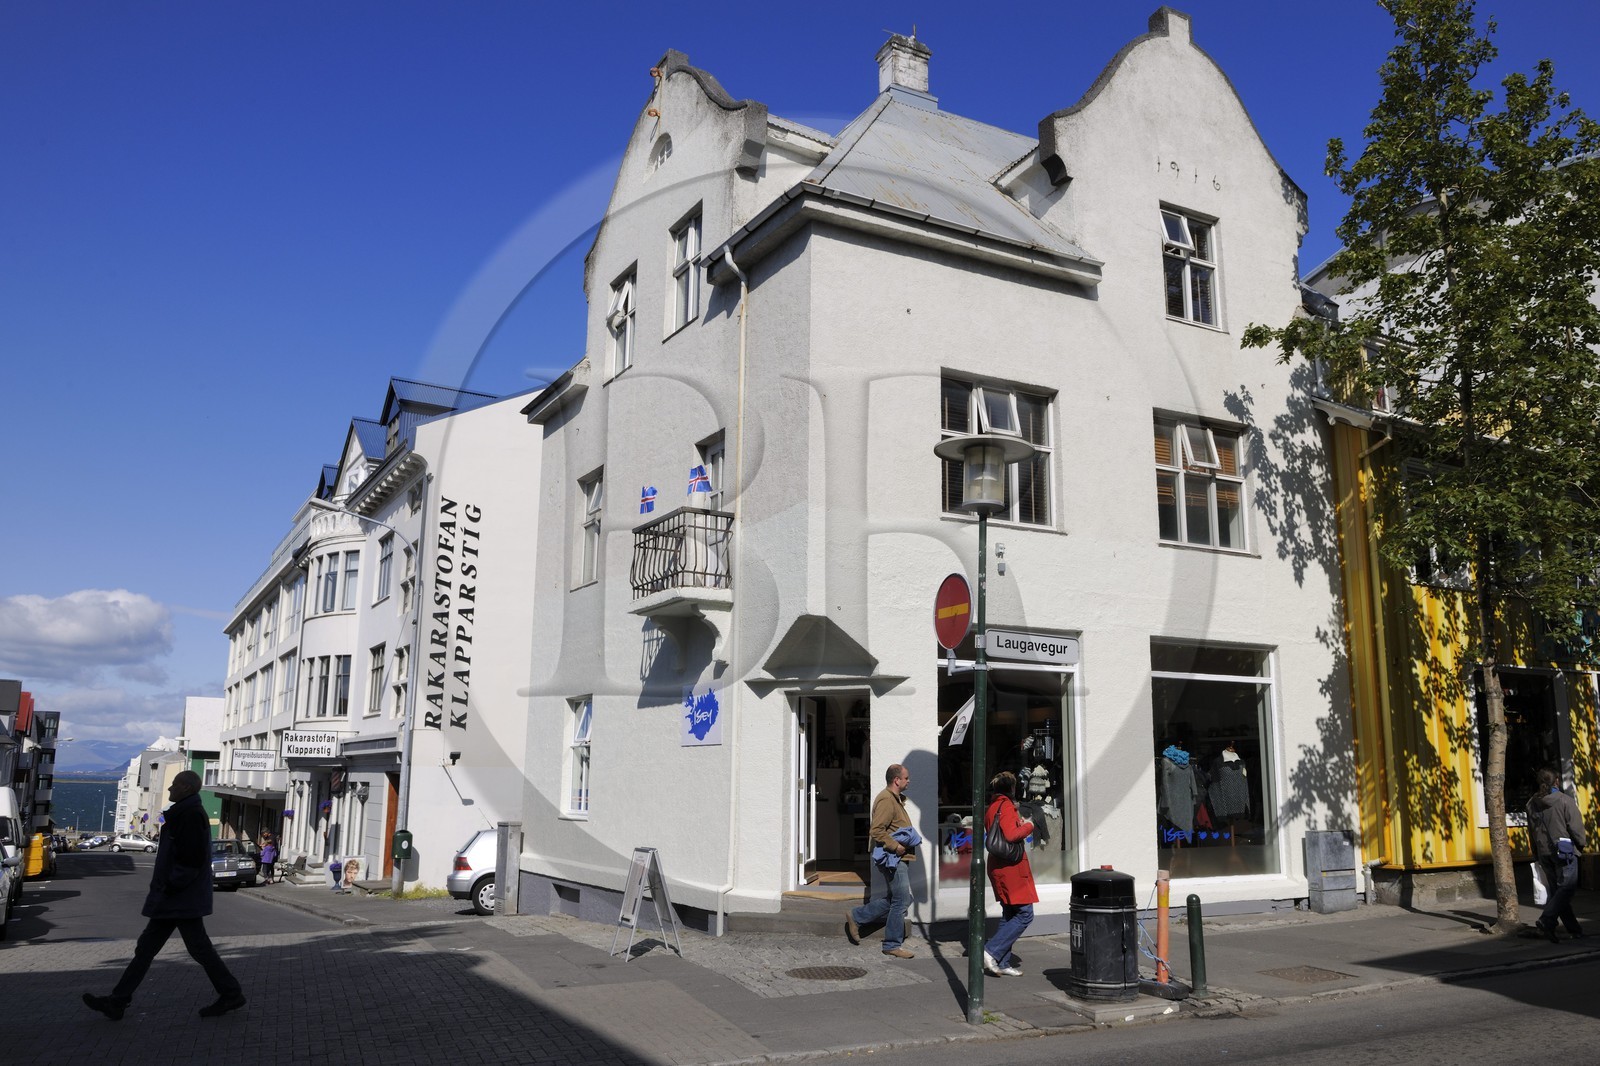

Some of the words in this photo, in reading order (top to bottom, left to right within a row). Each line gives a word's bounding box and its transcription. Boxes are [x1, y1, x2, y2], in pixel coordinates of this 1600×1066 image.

[1157, 155, 1221, 191] 1916
[424, 496, 458, 731] RAKARASTOFAN
[450, 503, 482, 731] KLAPPARSTÍG
[996, 635, 1068, 657] Laugavegur
[284, 732, 336, 743] Rakarastofan
